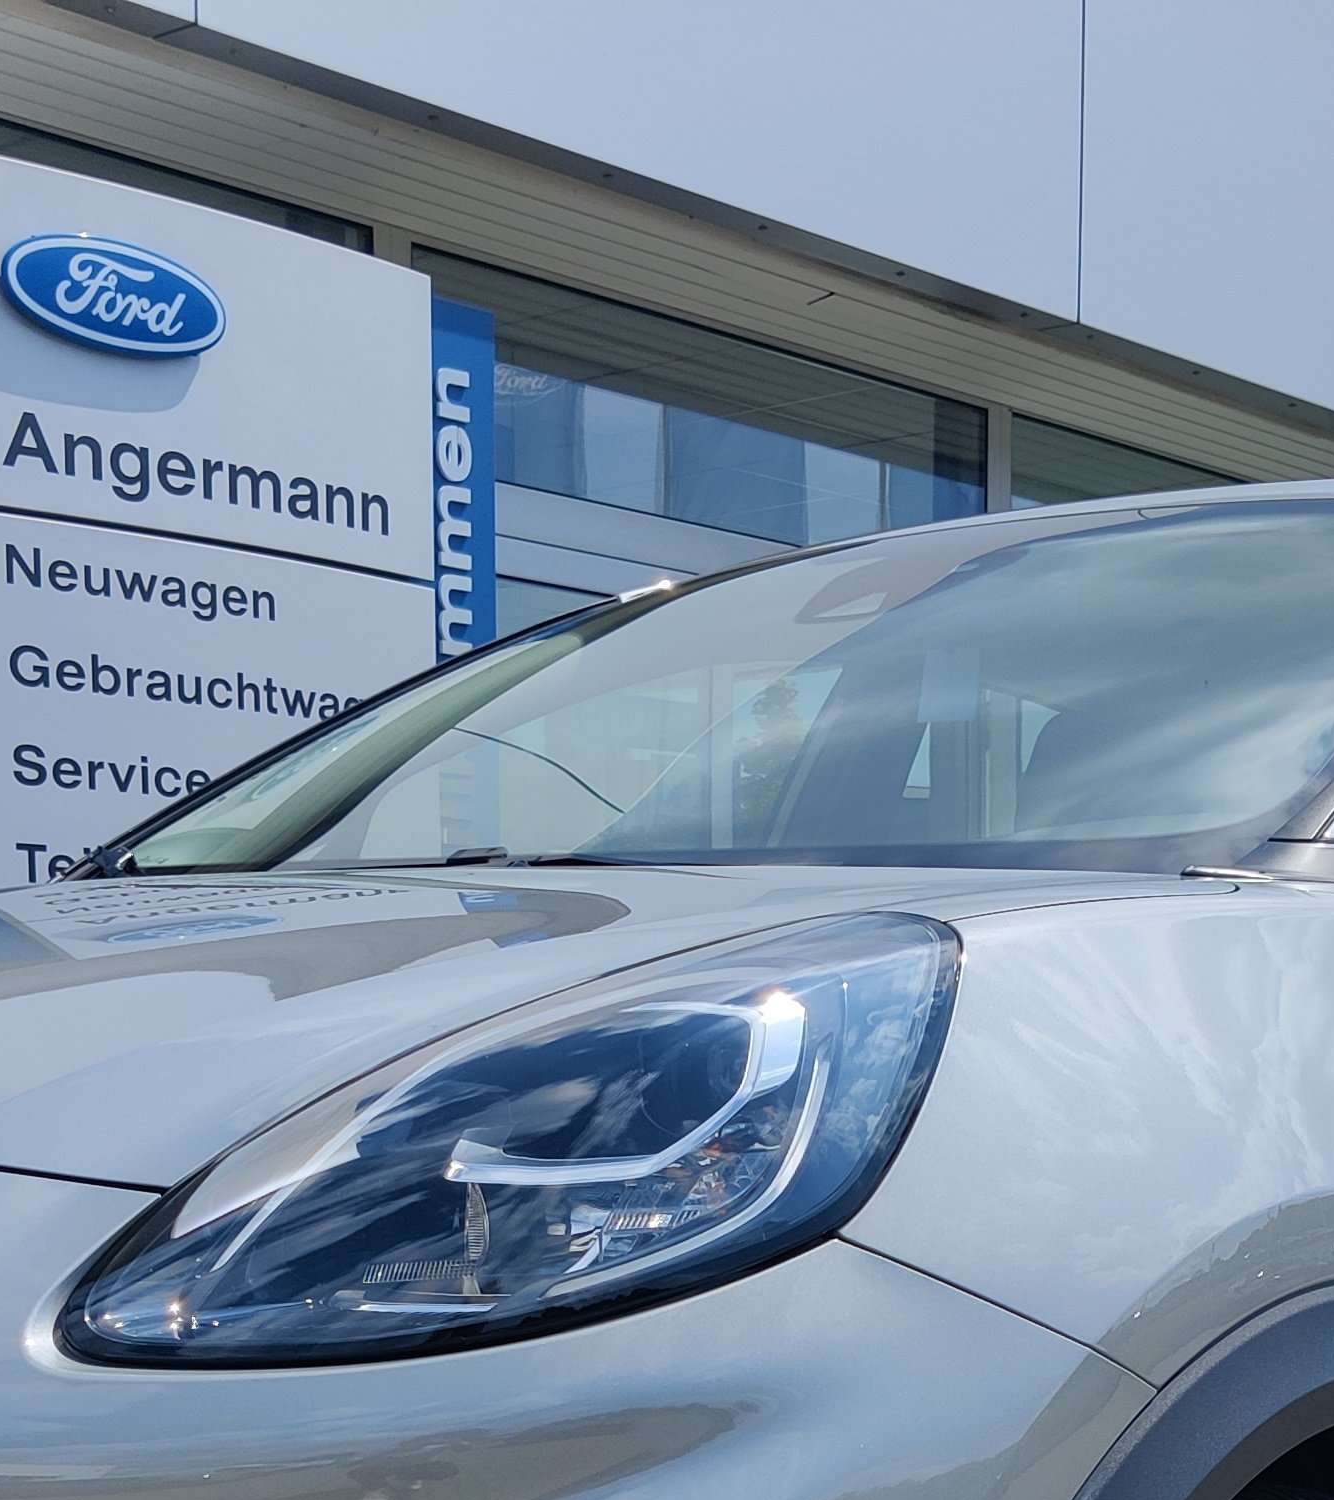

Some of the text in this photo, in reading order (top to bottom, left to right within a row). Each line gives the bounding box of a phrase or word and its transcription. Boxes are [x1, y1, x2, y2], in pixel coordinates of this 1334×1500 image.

[55, 252, 187, 337] Ford
[2, 411, 390, 537] Angermann
[5, 543, 276, 622] Neuwagen
[13, 744, 212, 798] Service
